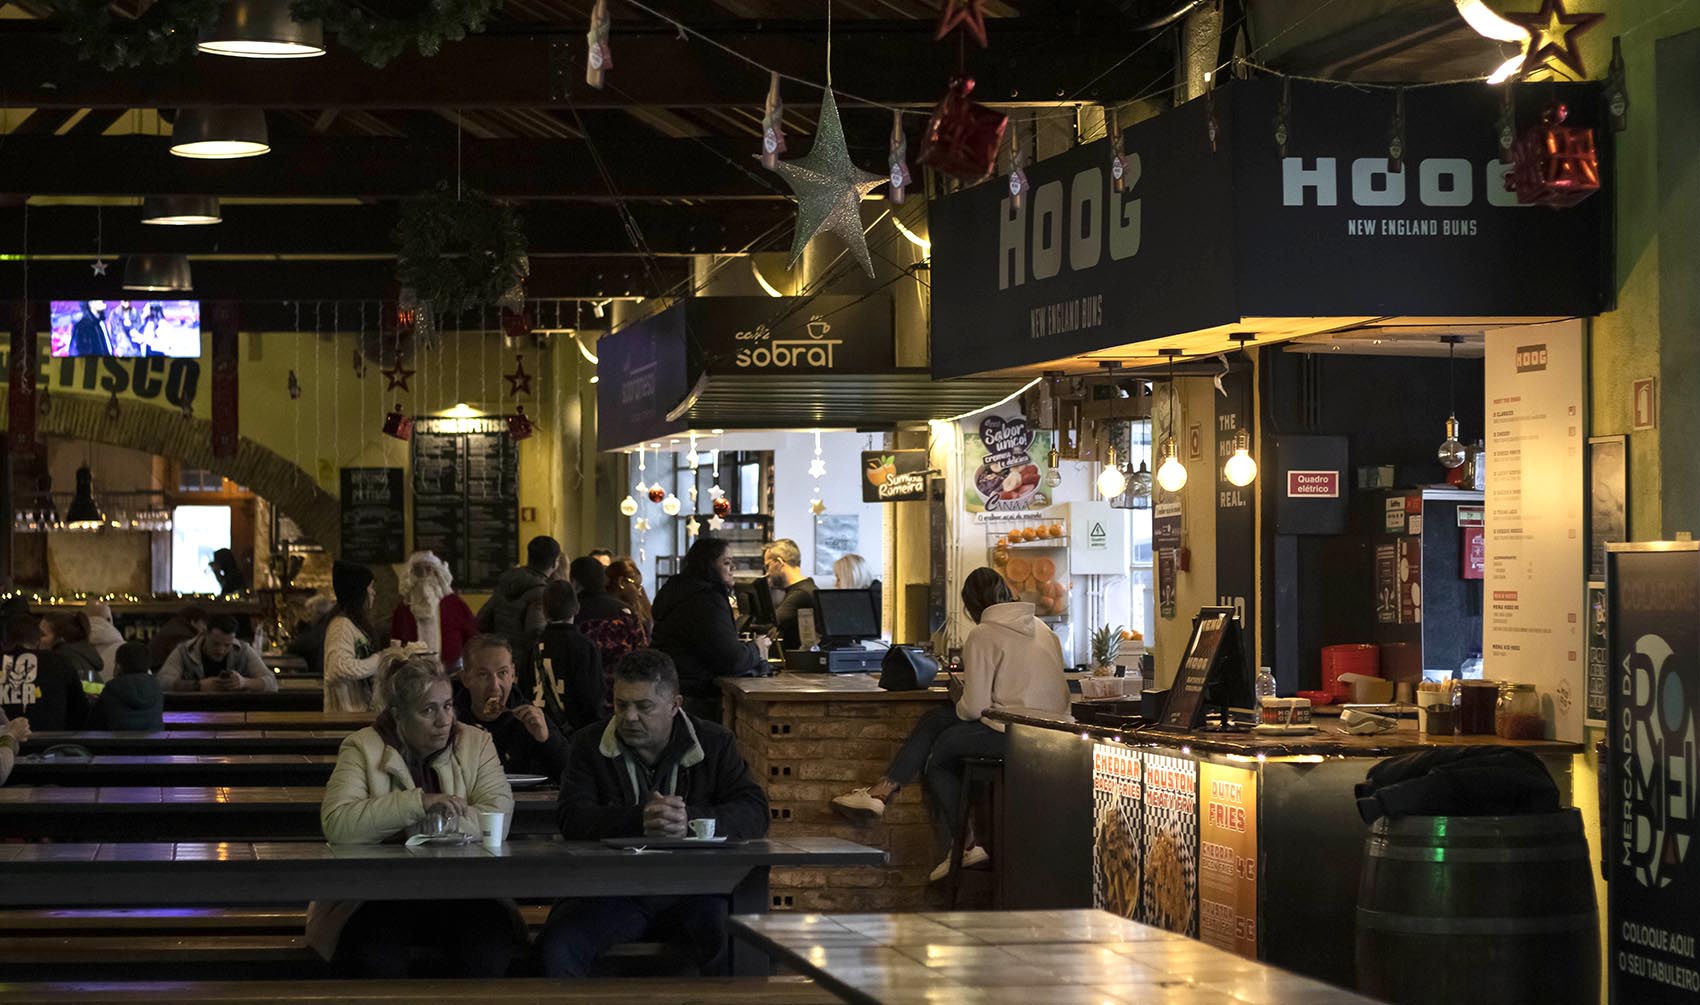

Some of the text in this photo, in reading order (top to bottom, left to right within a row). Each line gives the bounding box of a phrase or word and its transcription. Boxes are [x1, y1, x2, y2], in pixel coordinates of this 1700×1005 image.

[999, 153, 1142, 291] HOOG
[1348, 219, 1478, 236] NEW ENGLAND BUNS
[1030, 294, 1103, 338] NEW ENGLAND BUNS
[985, 423, 1025, 445] Sabor
[1219, 414, 1237, 431] THE
[1219, 438, 1238, 457] HOO
[879, 482, 924, 500] Romeira
[1297, 475, 1329, 484] Quadro
[1297, 484, 1329, 493] elétrico
[1220, 490, 1247, 507] REAL.
[1095, 753, 1140, 781] CHEDDAR
[1622, 653, 1633, 866] MERCADO DA
[1146, 766, 1195, 795] HOUSTON
[1211, 780, 1242, 803] DUTCH
[1208, 801, 1246, 833] FRIES
[1622, 920, 1695, 959] COLOQUE AQUI
[1619, 951, 1700, 992] O SEU TABULEIRO
